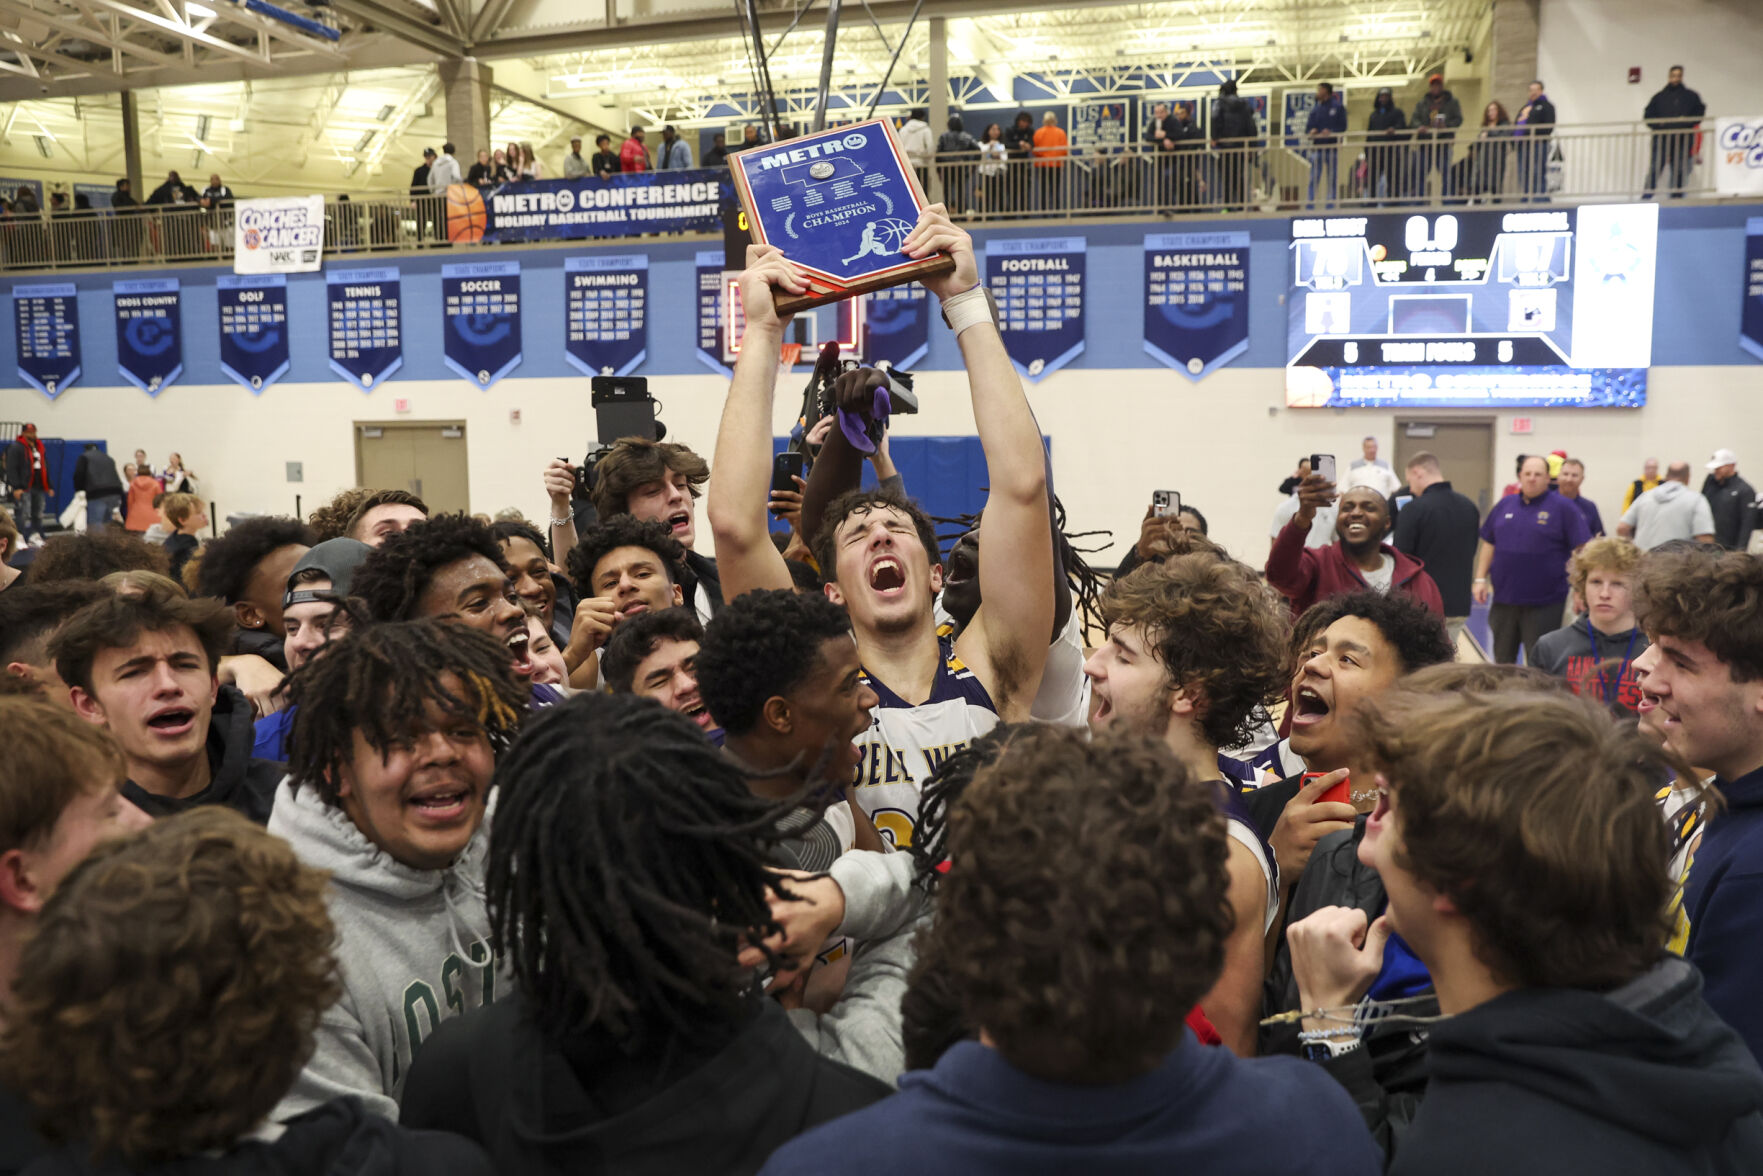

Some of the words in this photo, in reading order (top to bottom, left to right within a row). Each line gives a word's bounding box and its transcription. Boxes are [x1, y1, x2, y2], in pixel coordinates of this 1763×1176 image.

[761, 134, 867, 170] METRO
[493, 189, 575, 213] METRO
[579, 182, 720, 208] CONFERENCE
[240, 208, 307, 231] COACHES
[494, 214, 547, 228] HOLIDAY
[549, 209, 627, 226] BASKETBALL
[629, 204, 719, 221] TOURNAMENT
[803, 204, 876, 228] CHAMPION
[806, 211, 824, 220] BOYS
[825, 201, 868, 215] BASKETBALL
[260, 225, 320, 249] CANCER
[1002, 258, 1069, 272] FOOTBALL
[1154, 253, 1239, 267] BASKETBALL
[461, 280, 501, 293] SOCCER
[574, 274, 638, 287] SWIMMING
[239, 291, 264, 302] GOLF
[344, 285, 381, 298] TENNIS
[117, 297, 141, 307] CROSS
[142, 296, 177, 306] COUNTRY
[852, 741, 916, 789] BELL
